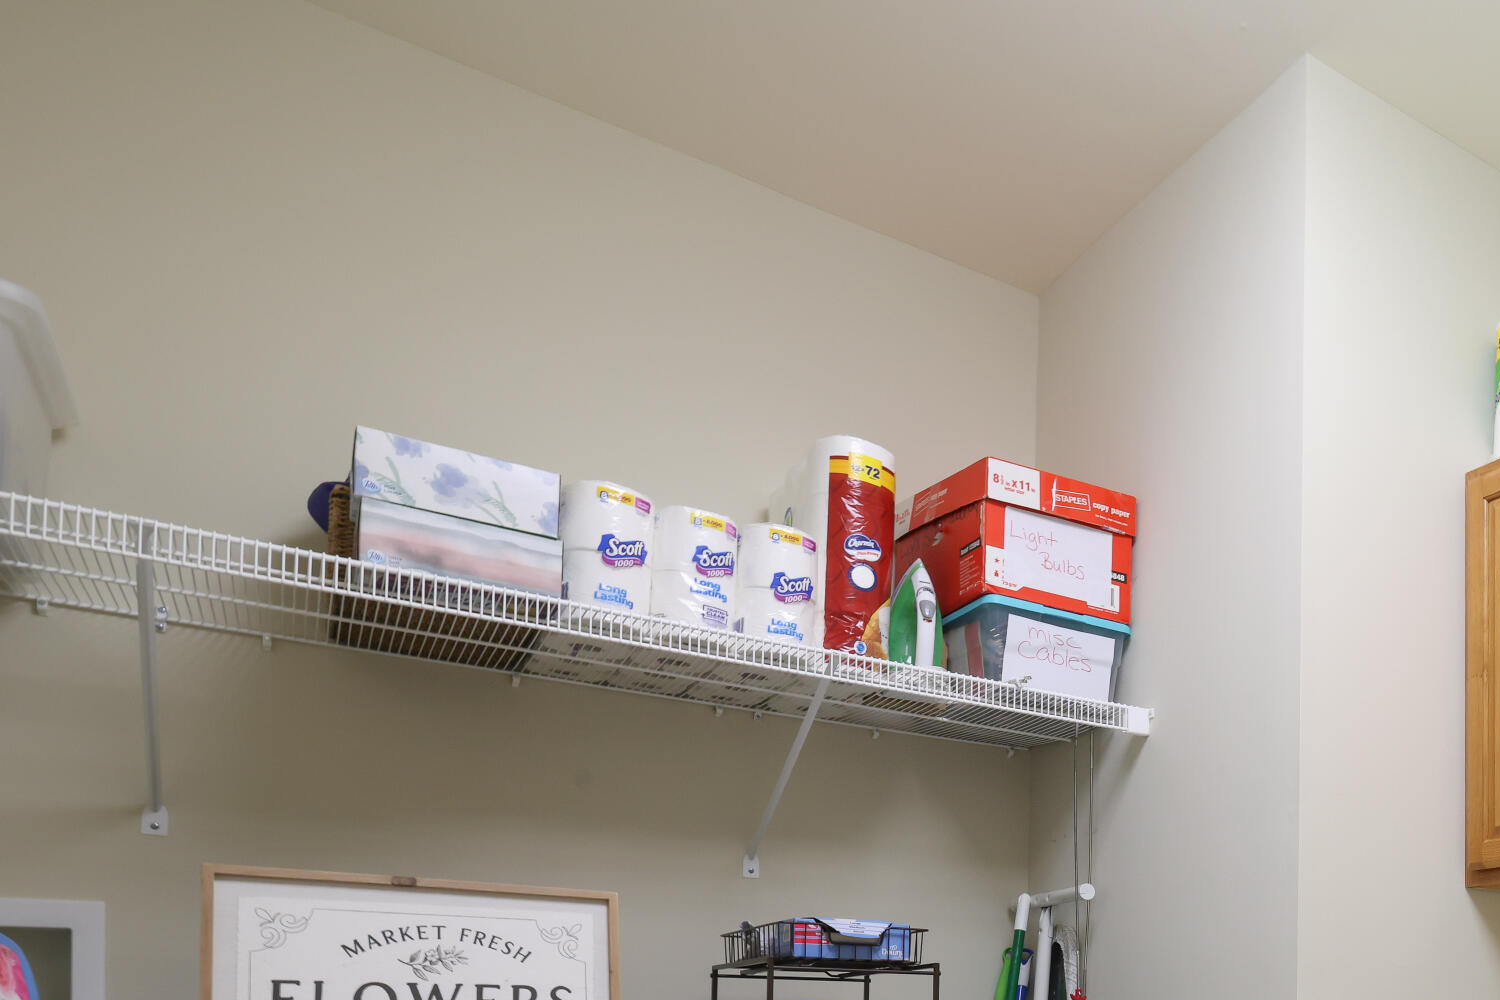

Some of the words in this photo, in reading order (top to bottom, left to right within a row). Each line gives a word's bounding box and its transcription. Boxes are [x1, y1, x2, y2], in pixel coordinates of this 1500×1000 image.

[1055, 493, 1088, 506] STAPLES
[1092, 502, 1109, 512] copy
[1111, 507, 1130, 518] paper
[1010, 520, 1058, 551] Light
[605, 537, 645, 558] Scott
[614, 559, 634, 567] 1000
[699, 549, 734, 567] Scott
[1039, 552, 1085, 580] Bulbs
[706, 569, 725, 578] 1000
[598, 583, 628, 598] Long
[777, 575, 811, 593] Scott
[594, 590, 634, 610] Lasting
[784, 595, 803, 603] 1000
[767, 625, 804, 641] Lasting
[1017, 640, 1092, 673] Cables
[340, 925, 447, 959] MARKET
[460, 928, 533, 964] FRESH
